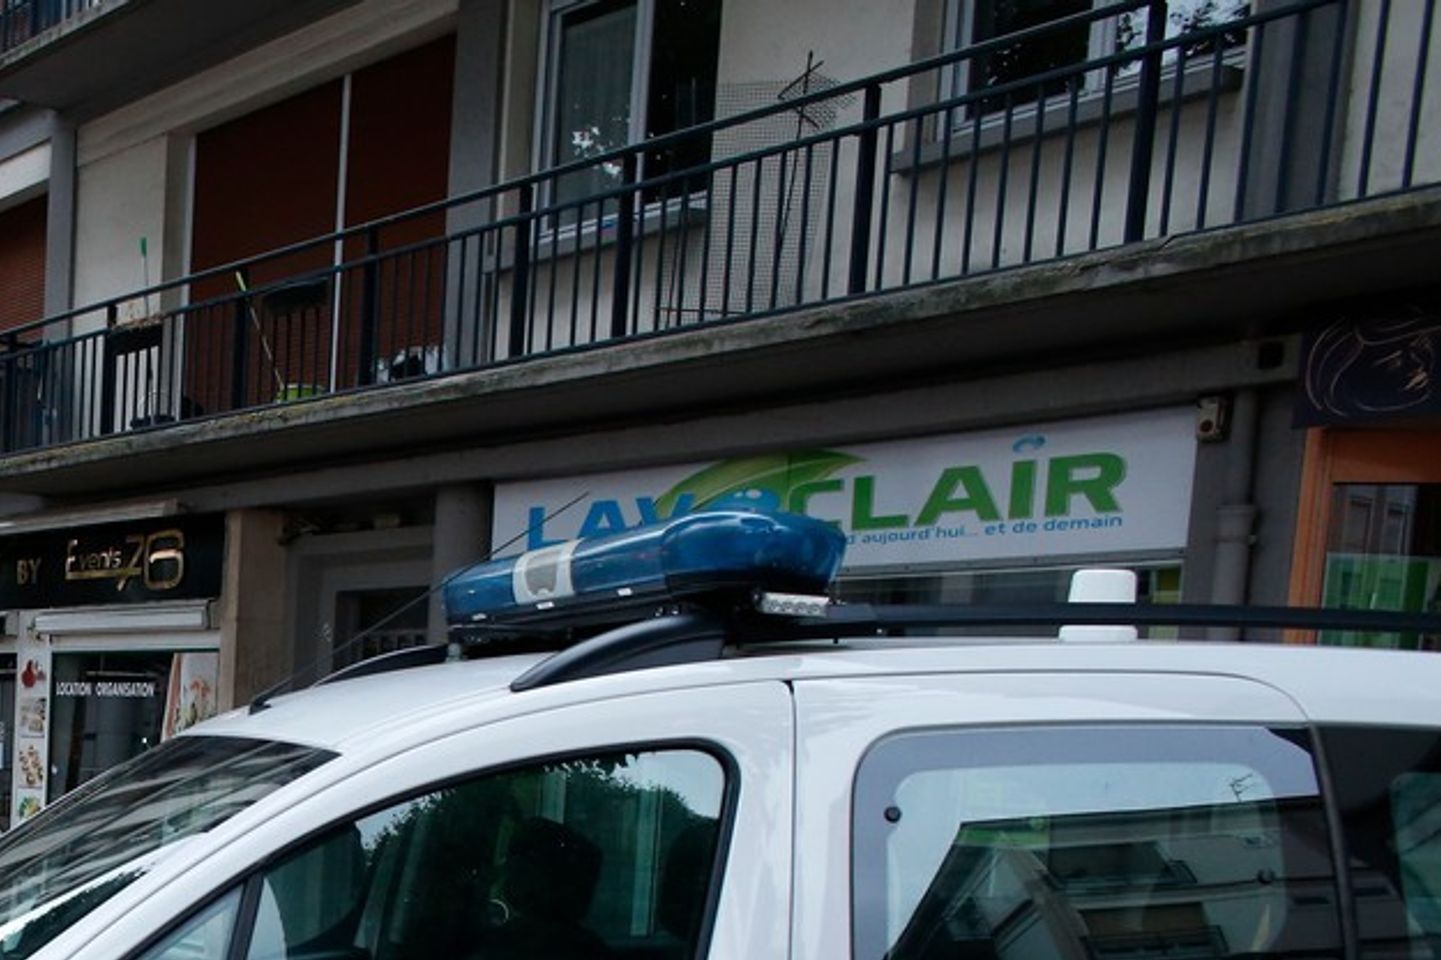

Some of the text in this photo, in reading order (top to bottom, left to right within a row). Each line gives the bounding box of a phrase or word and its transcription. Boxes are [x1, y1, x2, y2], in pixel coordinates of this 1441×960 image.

[985, 522, 1006, 536] et
[1013, 518, 1038, 534] de
[1044, 514, 1123, 533] demain
[17, 558, 42, 585] BY
[56, 681, 155, 698] LOCATION ORGANISATION
